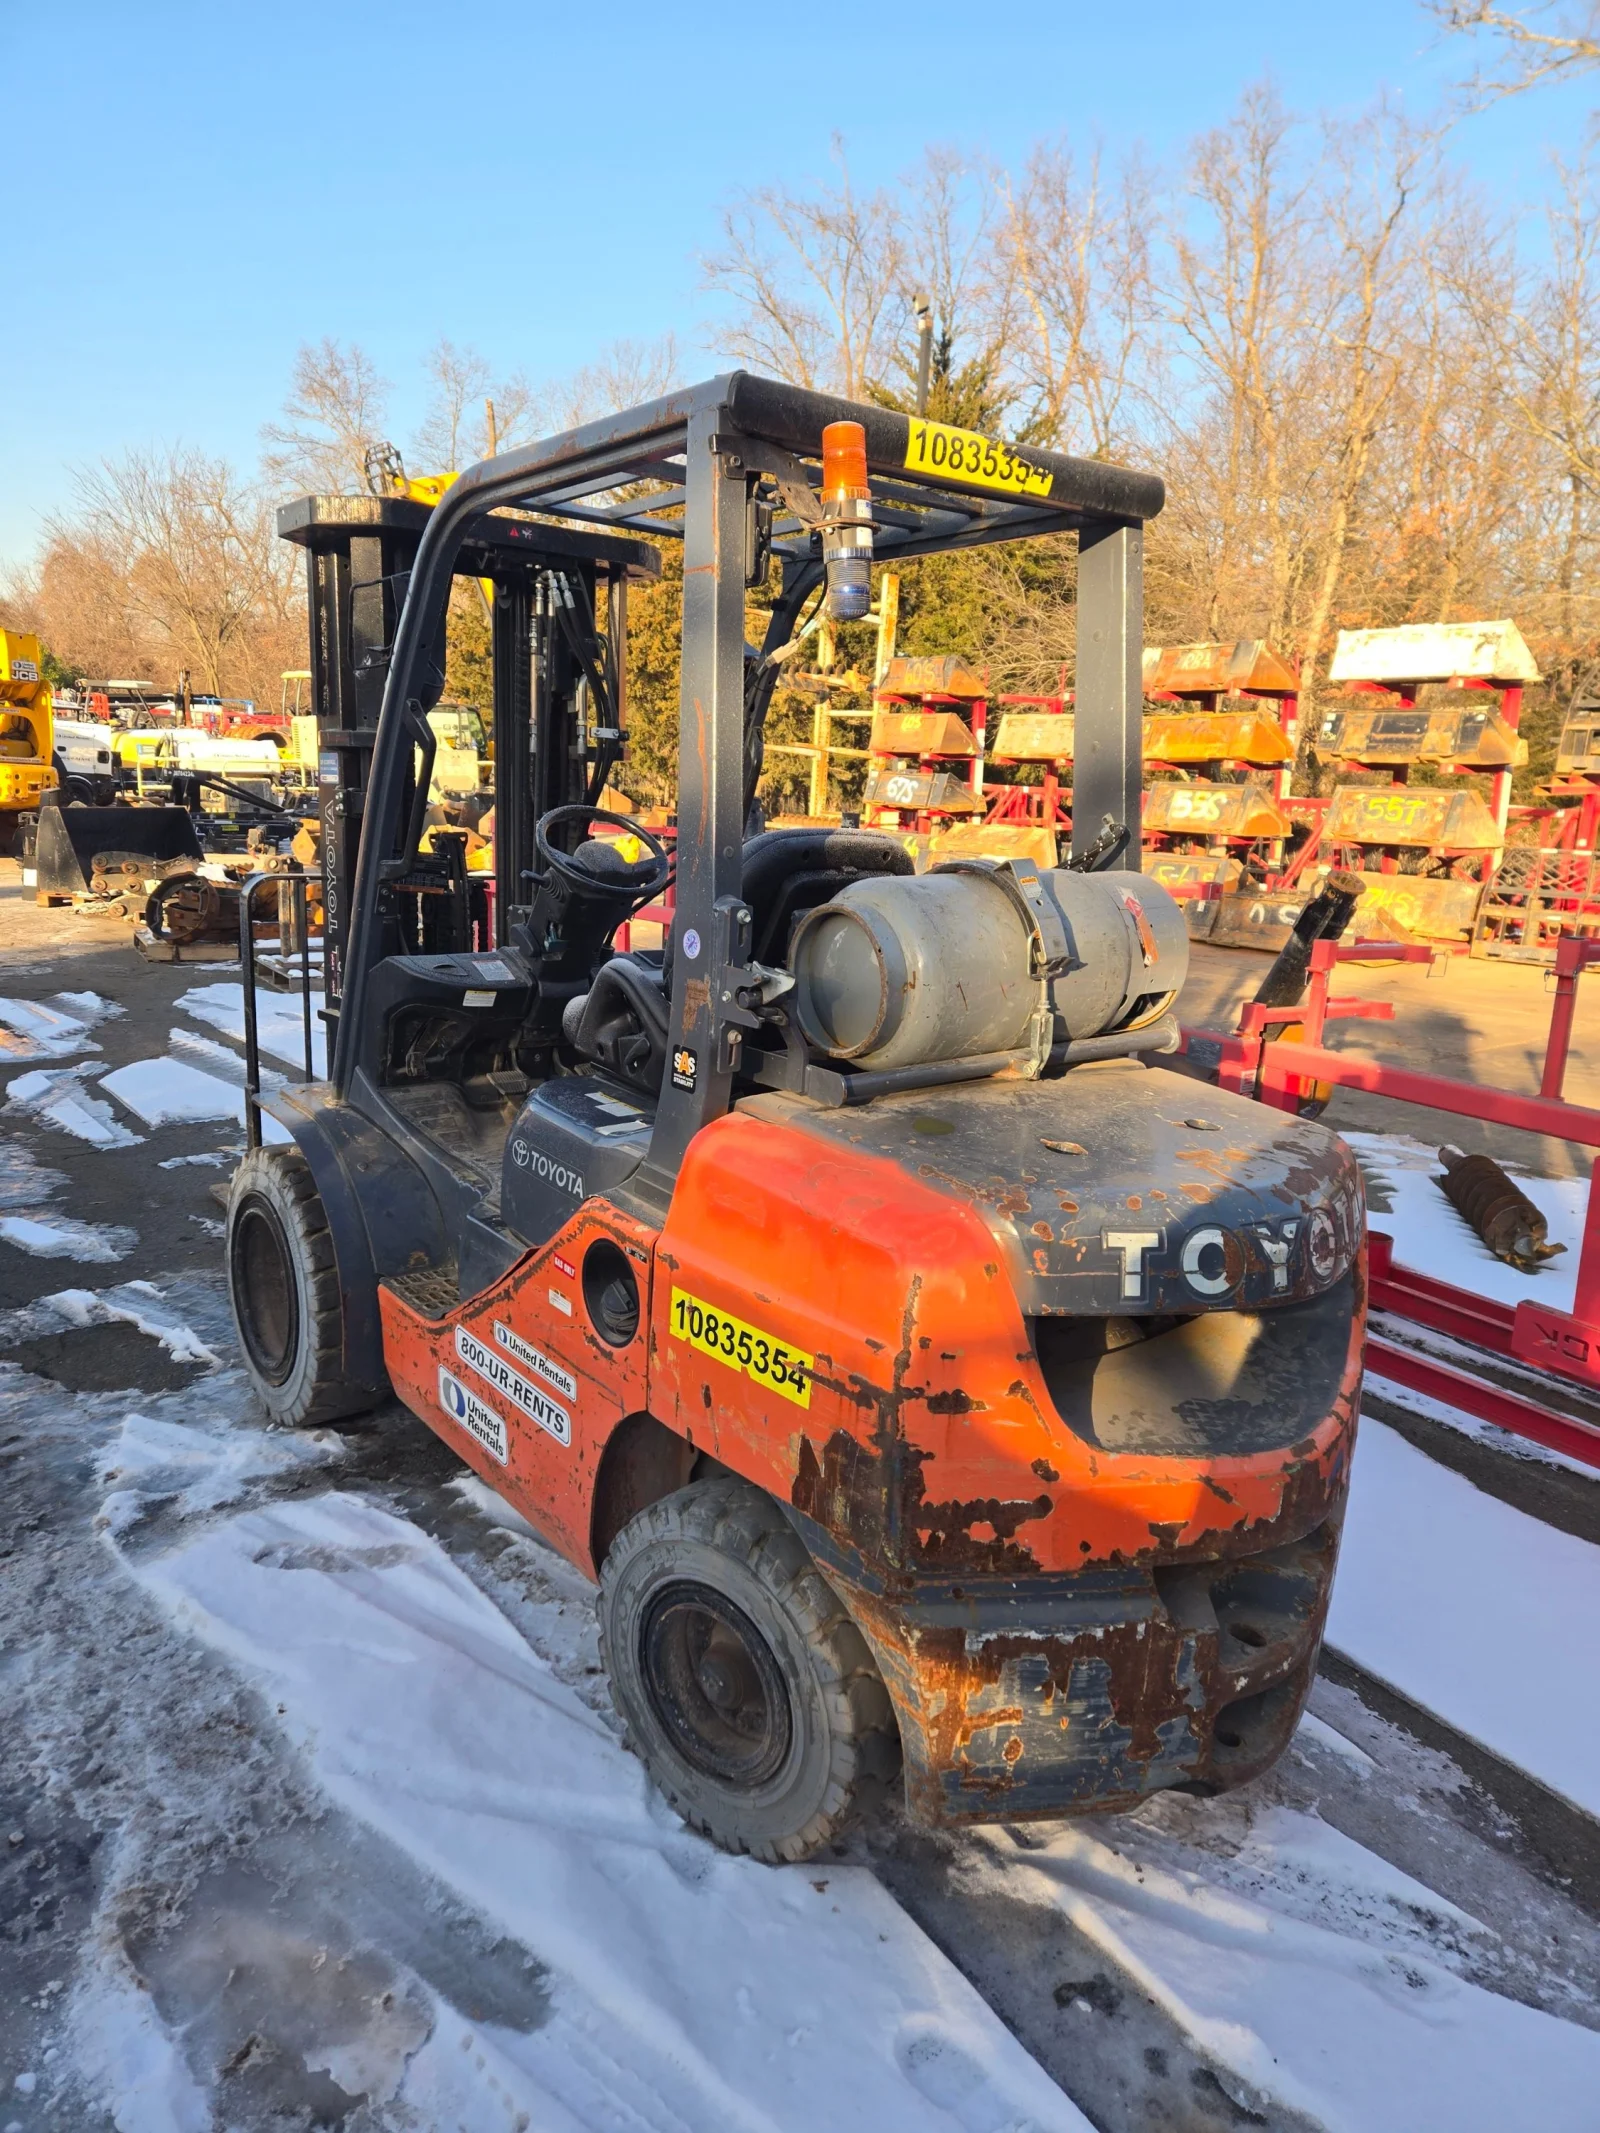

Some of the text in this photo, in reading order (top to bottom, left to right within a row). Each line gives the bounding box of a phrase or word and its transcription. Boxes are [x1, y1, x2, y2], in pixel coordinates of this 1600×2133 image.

[11, 671, 38, 681] JCB
[324, 800, 338, 933] TOYOTA
[674, 1051, 696, 1075] SAS
[531, 1151, 584, 1199] TOYOTA
[509, 1336, 571, 1392] United Rentals
[676, 1299, 806, 1395] 10835354
[461, 1337, 564, 1433] 800-UR-RENTS
[467, 1397, 500, 1436] United
[468, 1415, 504, 1456] Rentals
